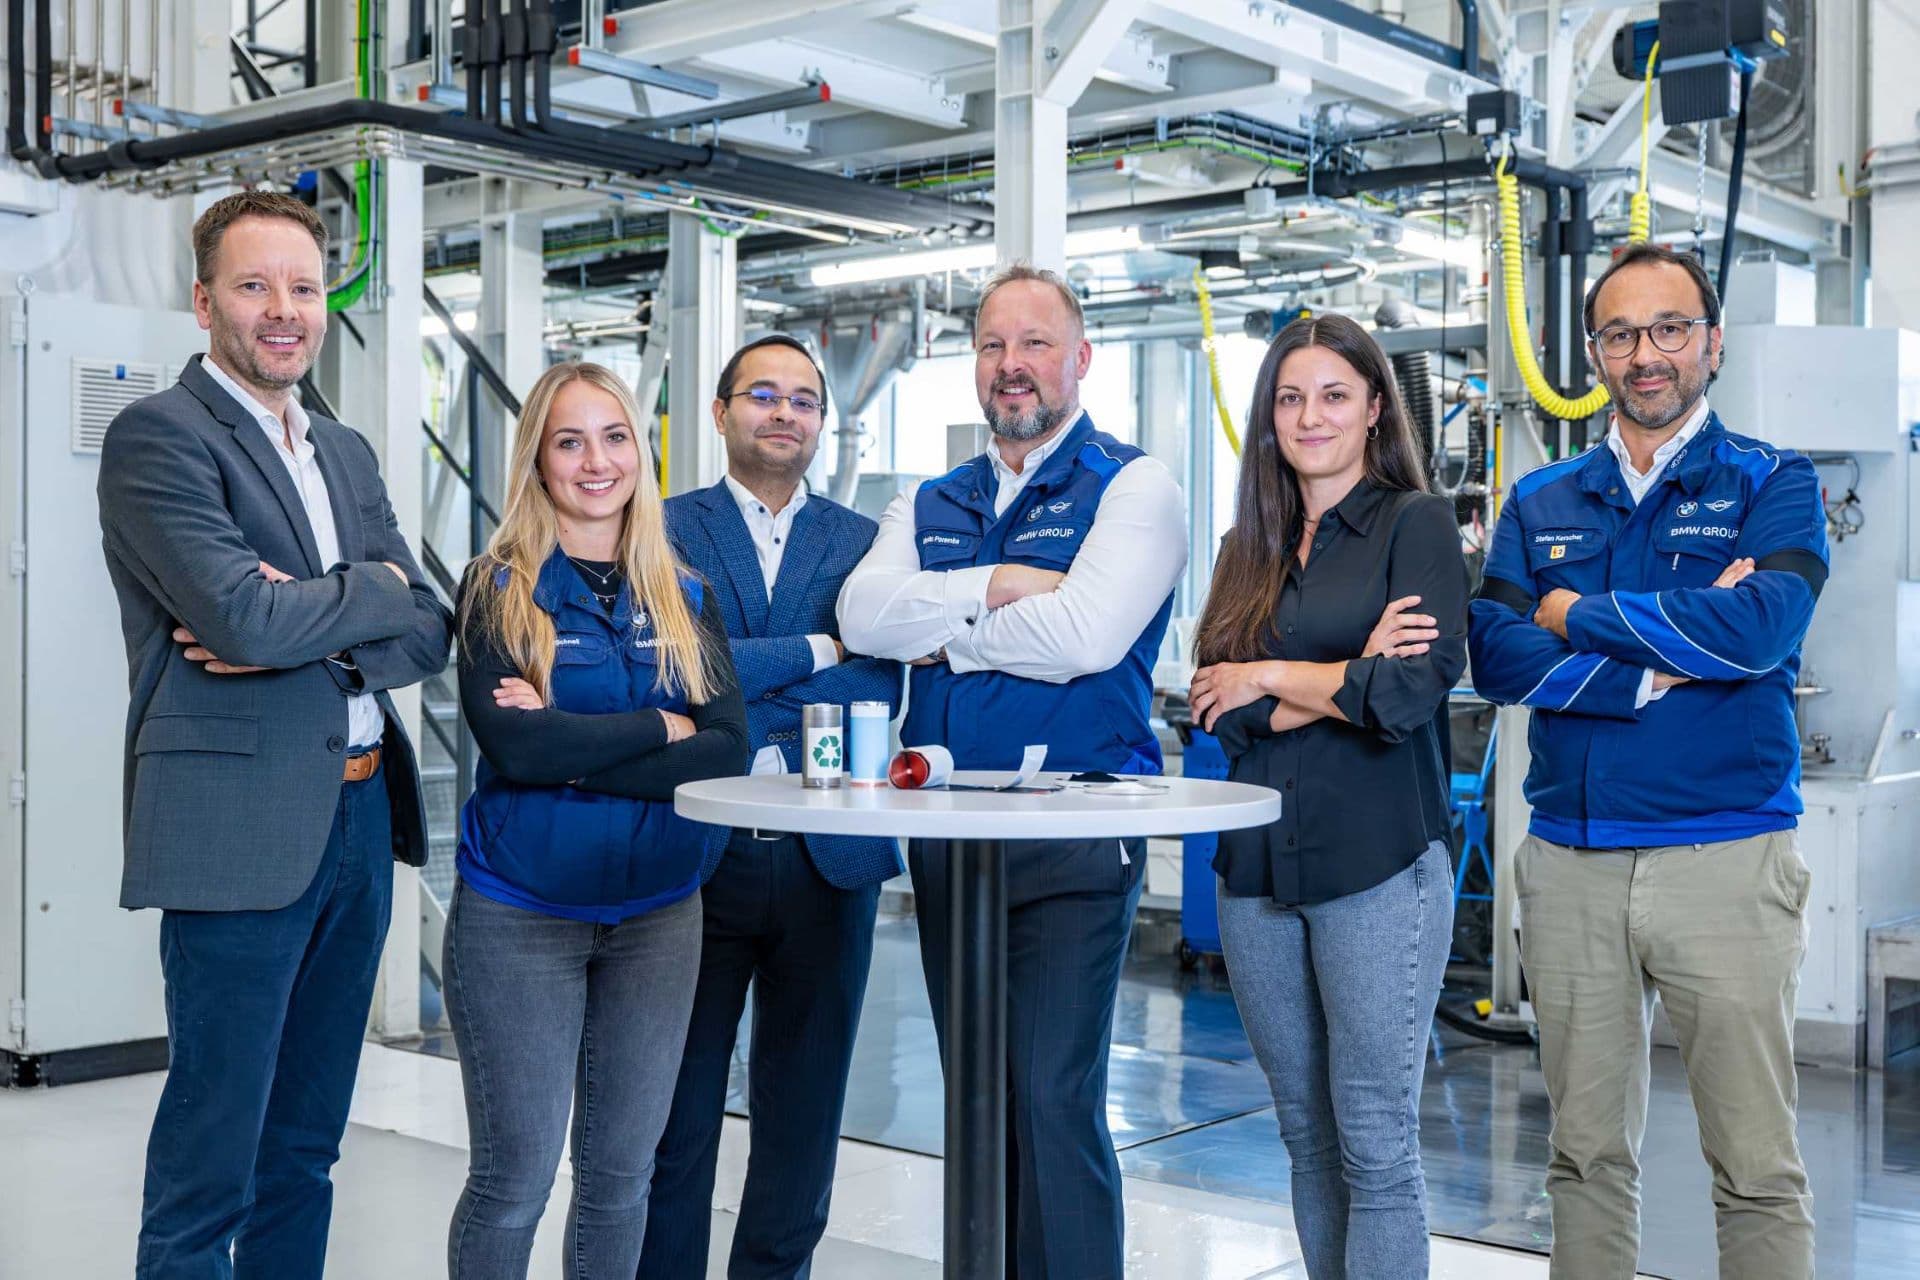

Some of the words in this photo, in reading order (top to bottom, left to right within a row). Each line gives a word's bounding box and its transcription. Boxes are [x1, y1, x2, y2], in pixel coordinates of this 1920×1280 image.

[1038, 528, 1074, 538] GROUP
[1670, 526, 1701, 537] BMW
[1702, 526, 1739, 539] GROUP
